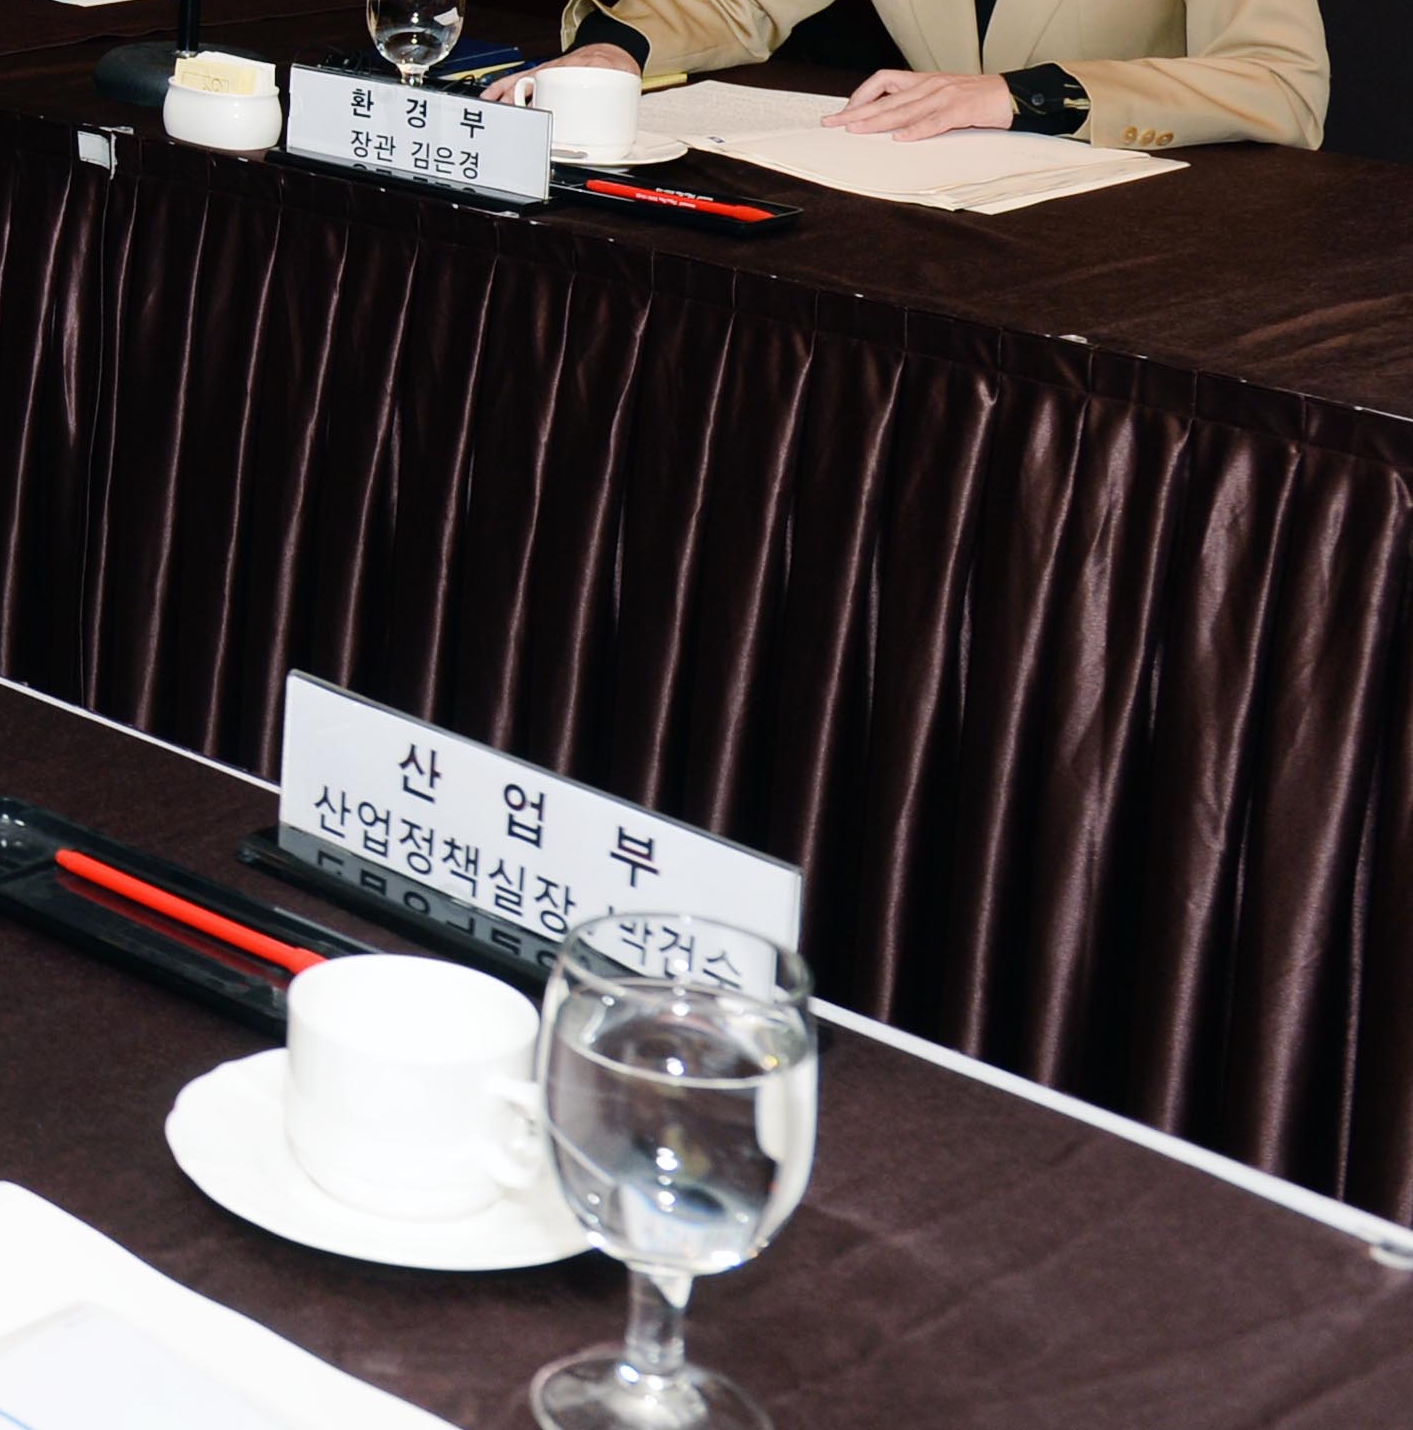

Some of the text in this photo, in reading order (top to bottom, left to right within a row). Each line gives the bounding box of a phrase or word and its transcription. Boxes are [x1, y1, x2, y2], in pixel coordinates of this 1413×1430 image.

[350, 129, 479, 180] 장관 김은경
[314, 784, 577, 936] 산업정책실장
